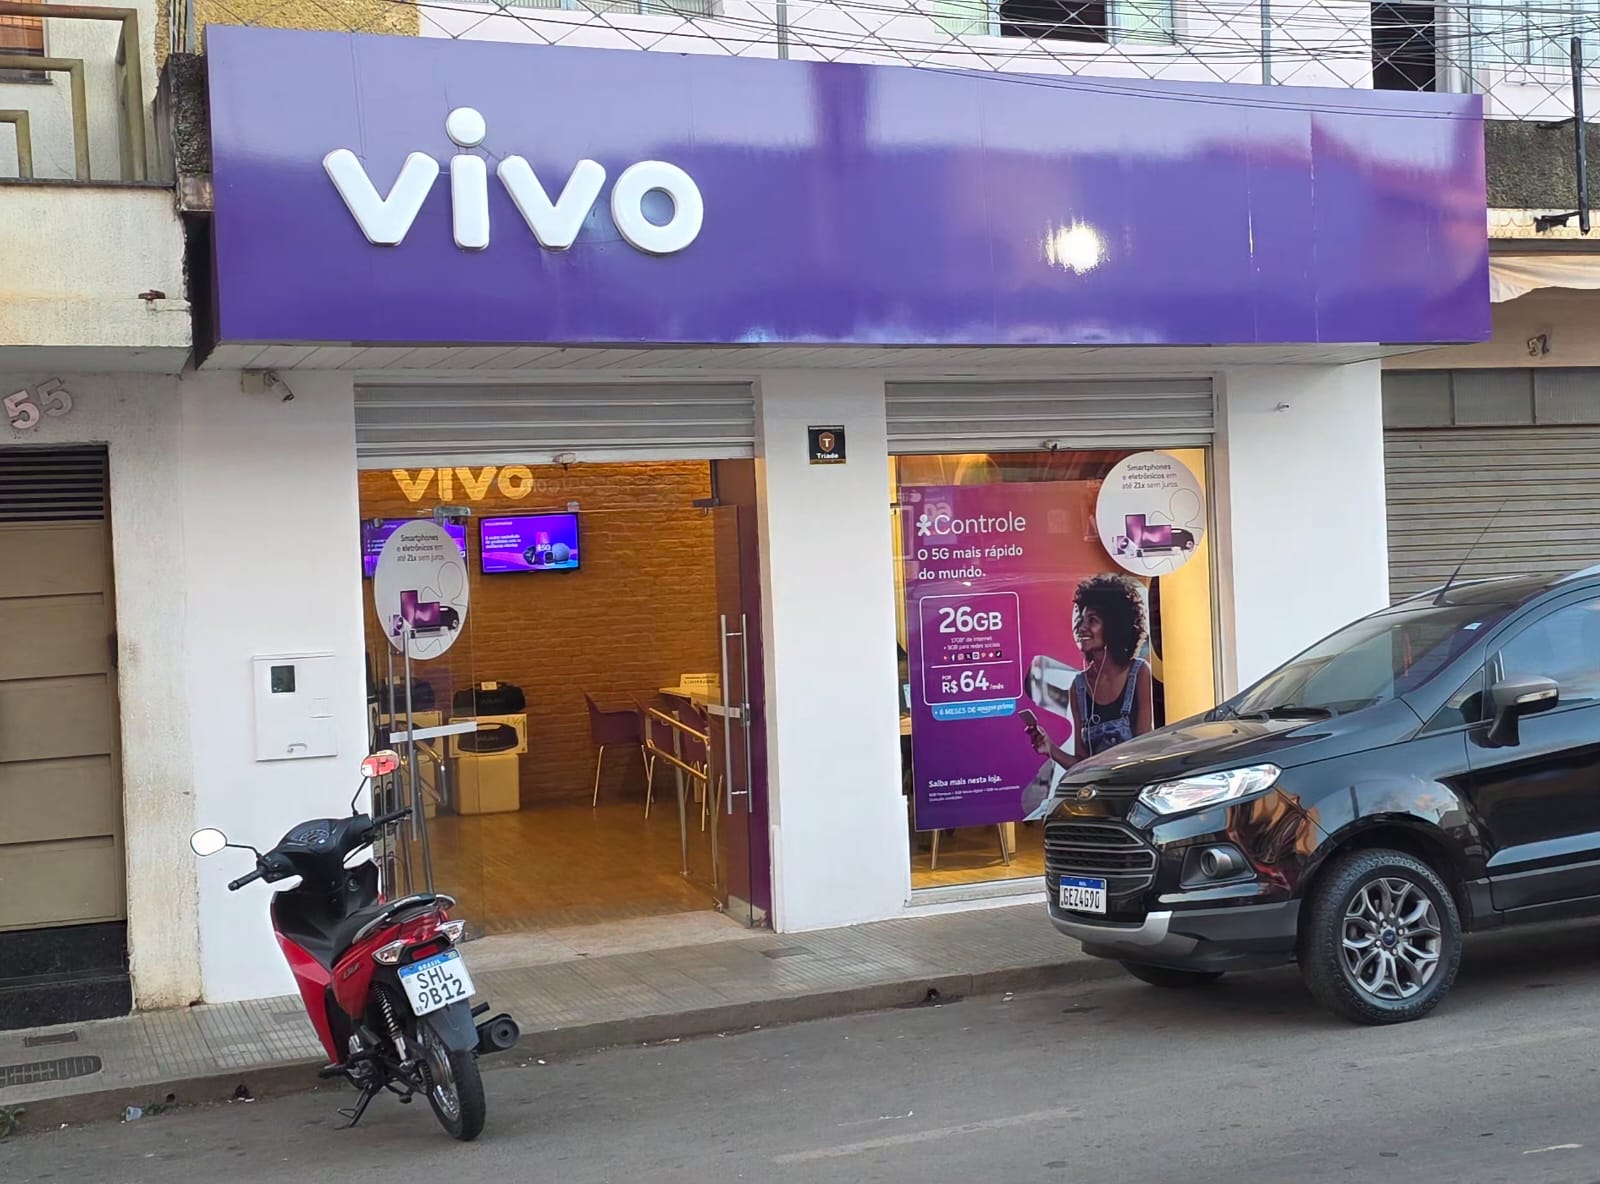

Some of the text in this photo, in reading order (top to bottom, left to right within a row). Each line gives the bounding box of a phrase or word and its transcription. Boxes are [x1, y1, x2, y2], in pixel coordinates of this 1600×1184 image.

[322, 107, 704, 254] vivo
[4, 377, 73, 429] 55
[391, 464, 534, 502] vivo
[934, 511, 1027, 535] Controle
[400, 534, 439, 542] Smartphones
[917, 544, 1023, 561] O 5G mais rápido
[918, 566, 986, 580] do mundo.
[938, 606, 1003, 633] 26GB
[942, 680, 958, 694] R$
[960, 670, 990, 692] 64
[928, 779, 949, 788] Saiba
[949, 777, 967, 786] mais
[967, 776, 987, 785] nesta
[416, 965, 453, 990] SHL
[418, 979, 466, 1009] 9B12
